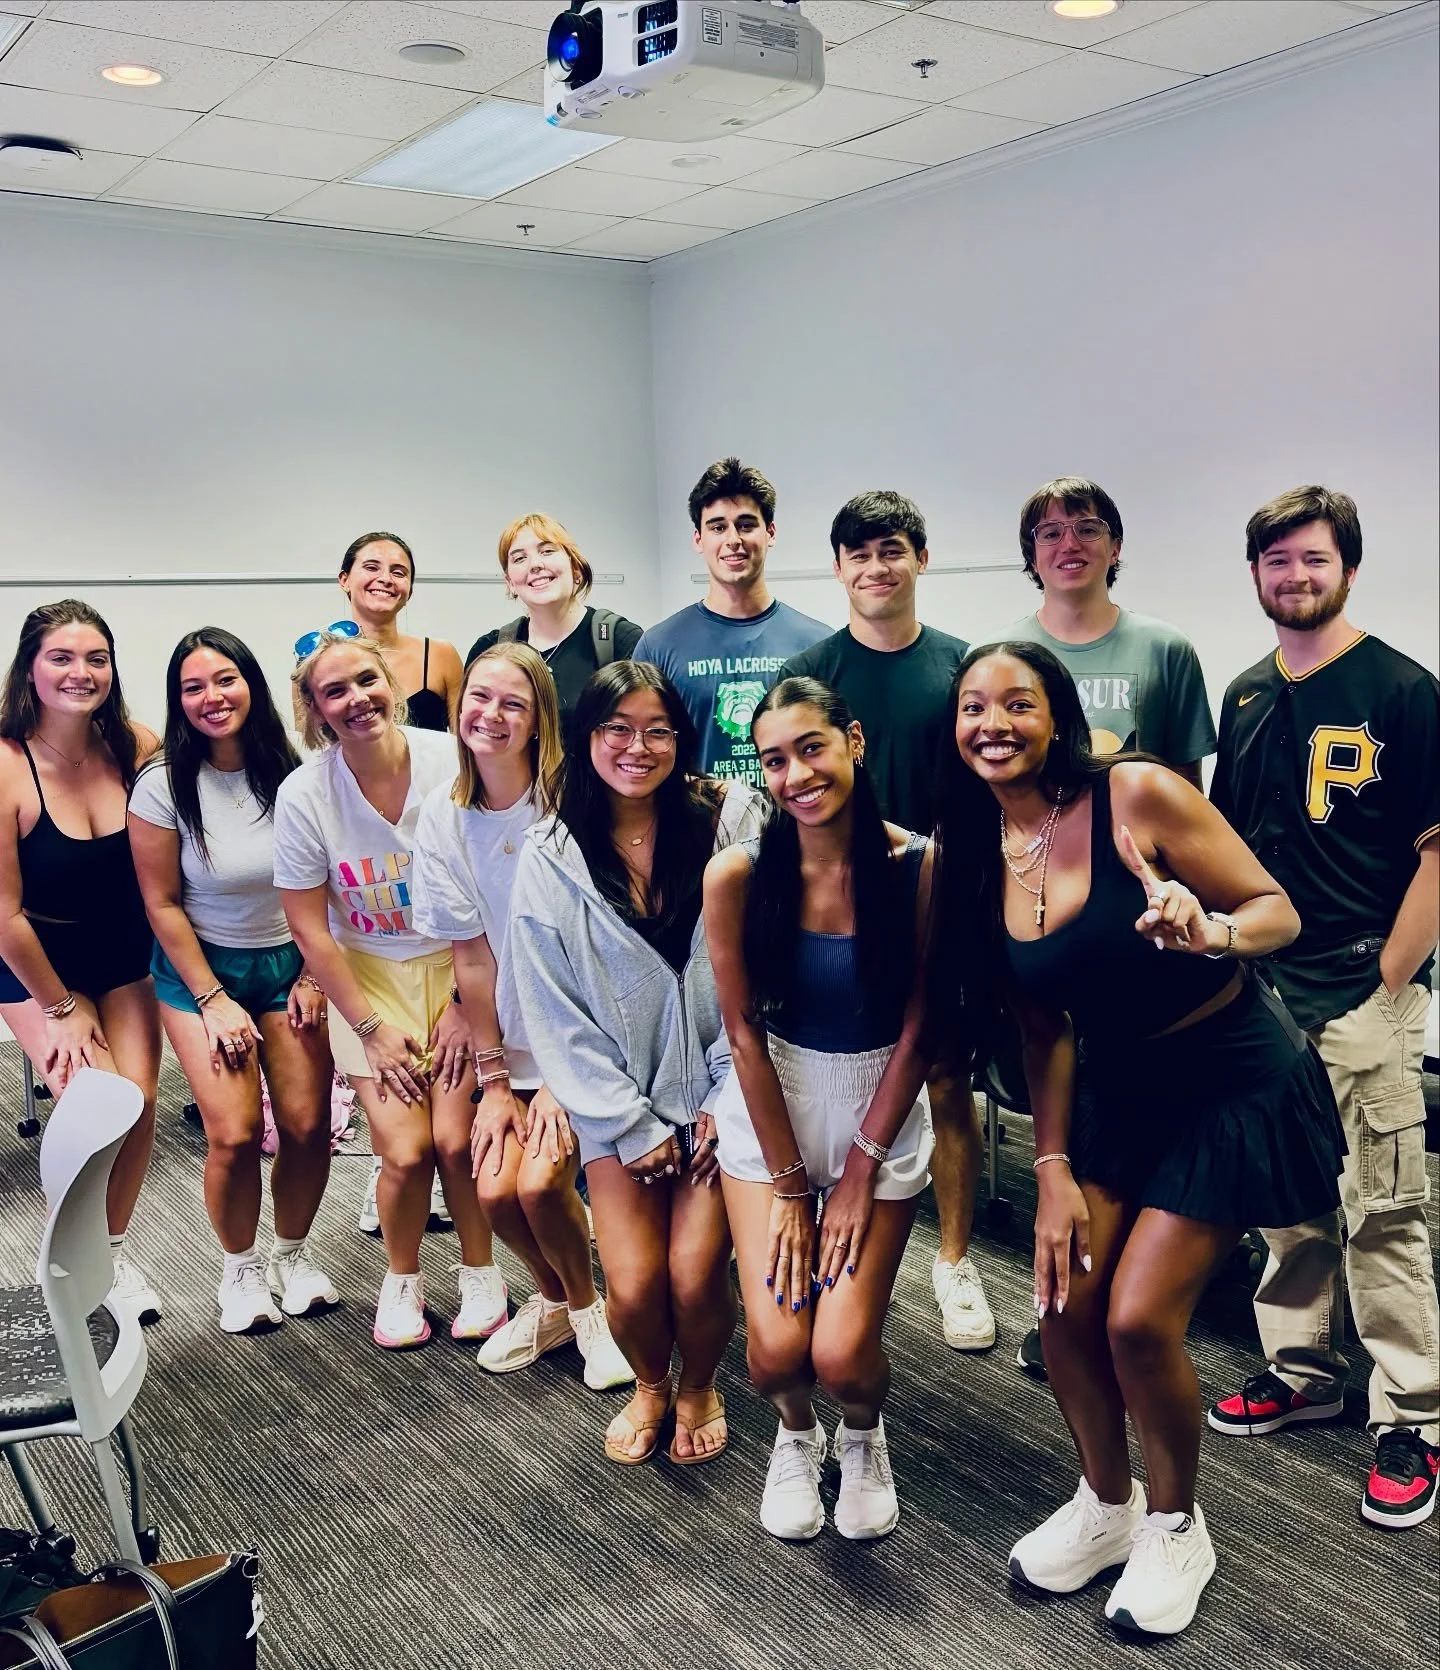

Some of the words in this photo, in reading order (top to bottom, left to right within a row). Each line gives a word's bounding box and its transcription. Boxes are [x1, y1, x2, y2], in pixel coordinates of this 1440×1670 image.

[688, 658, 723, 677] HOYA
[726, 656, 788, 675] LACROSS
[1077, 678, 1131, 711] SUR
[731, 743, 756, 756] 2022
[713, 759, 737, 773] AREA
[739, 759, 746, 771] 3
[1306, 721, 1385, 823] P
[338, 850, 413, 887] ALP
[342, 881, 412, 911] CHI
